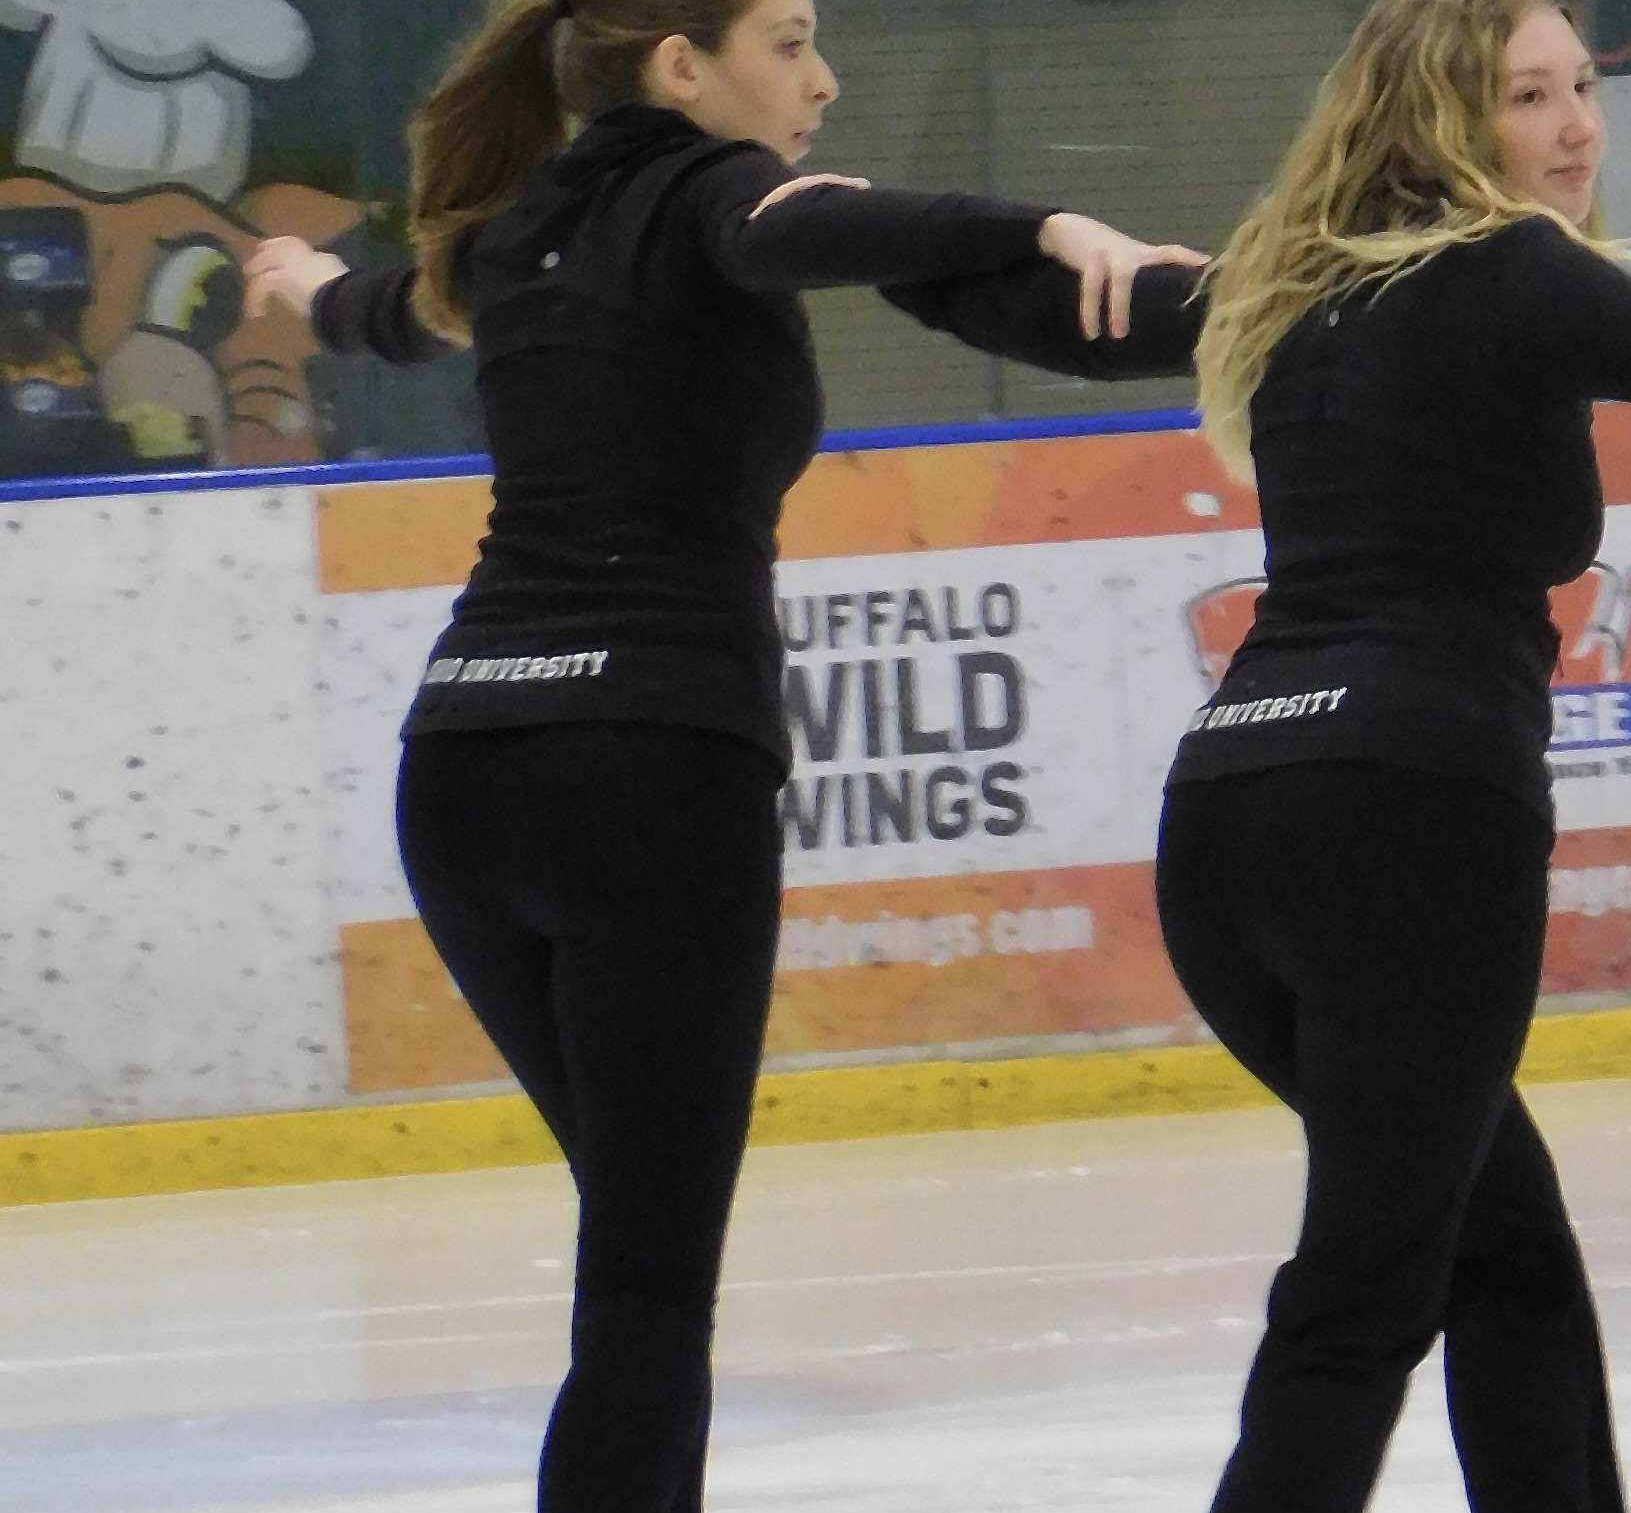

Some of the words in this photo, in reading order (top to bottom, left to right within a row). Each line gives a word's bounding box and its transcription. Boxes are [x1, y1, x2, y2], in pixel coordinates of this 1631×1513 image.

[778, 582, 1023, 653] UFFALO
[459, 650, 609, 683] UNIVERSITY
[1207, 686, 1348, 730] UNIVERSITY
